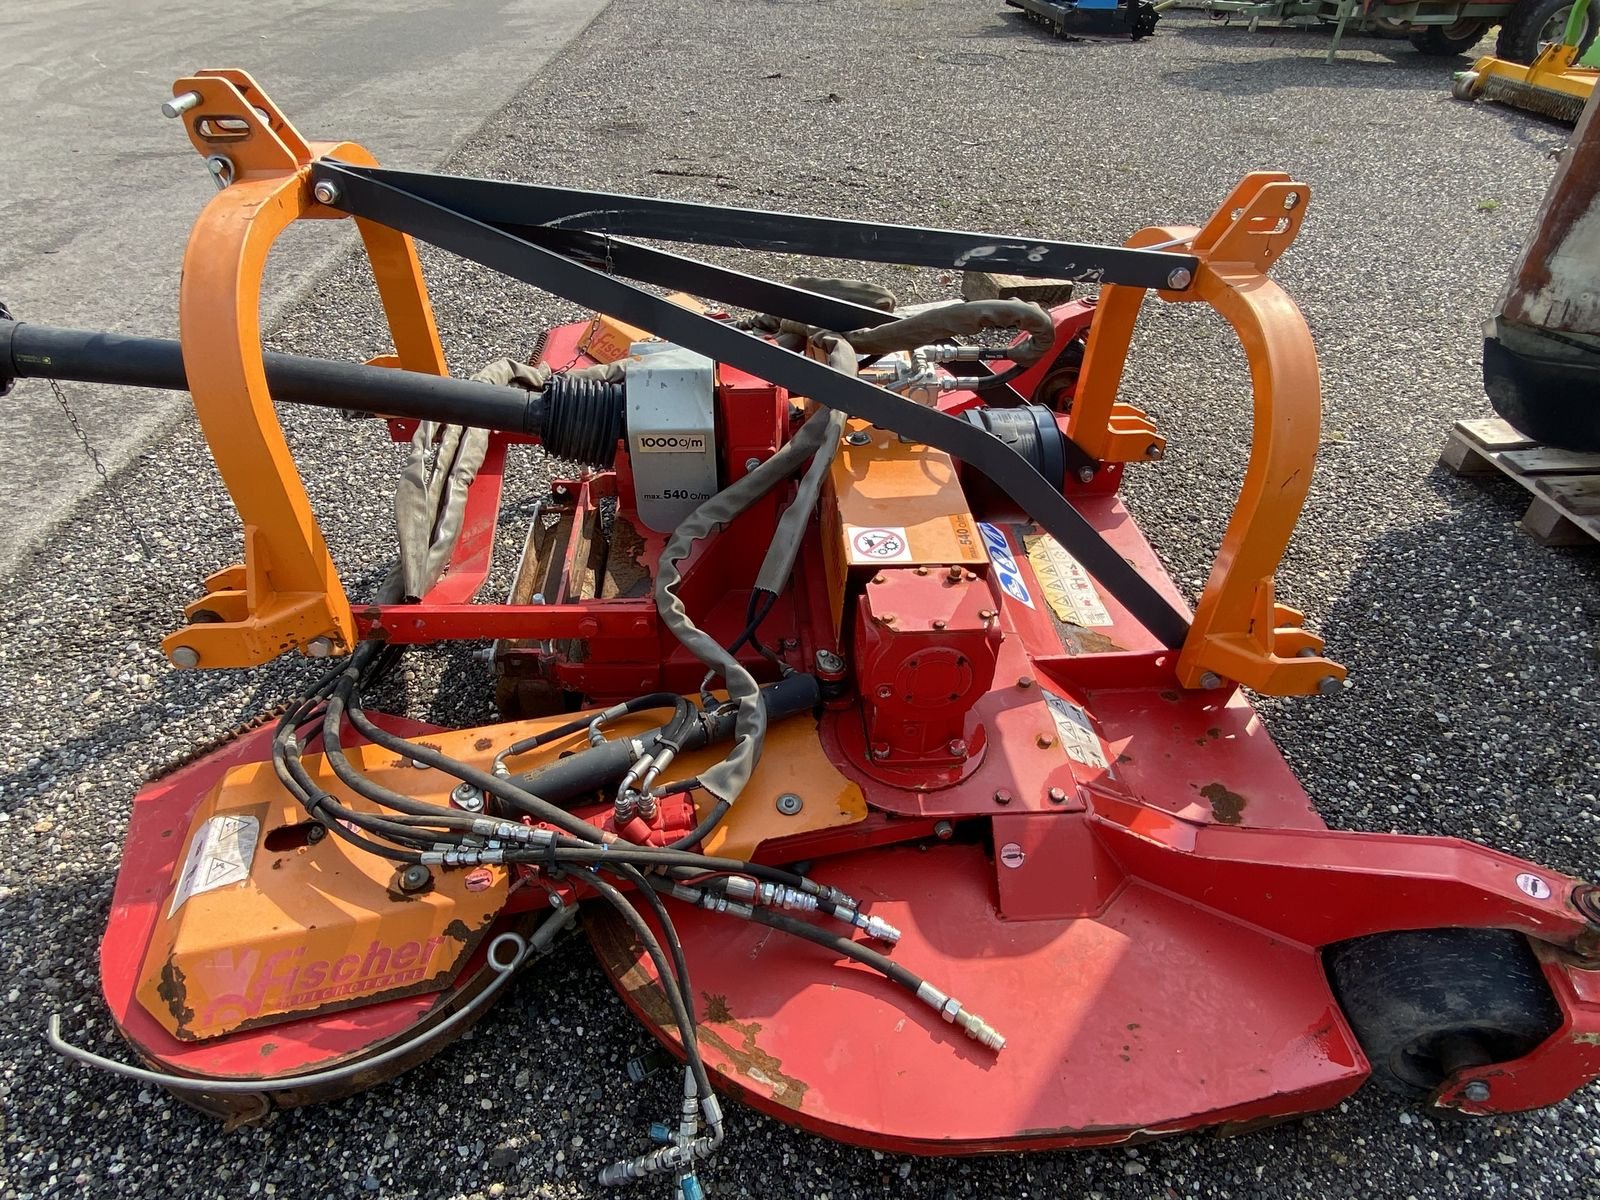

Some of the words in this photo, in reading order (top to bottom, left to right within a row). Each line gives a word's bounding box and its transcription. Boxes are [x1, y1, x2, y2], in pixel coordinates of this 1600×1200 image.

[641, 437, 678, 448] 1000
[663, 489, 688, 500] 540
[956, 528, 972, 545] 540
[254, 936, 447, 1016] Fischer
